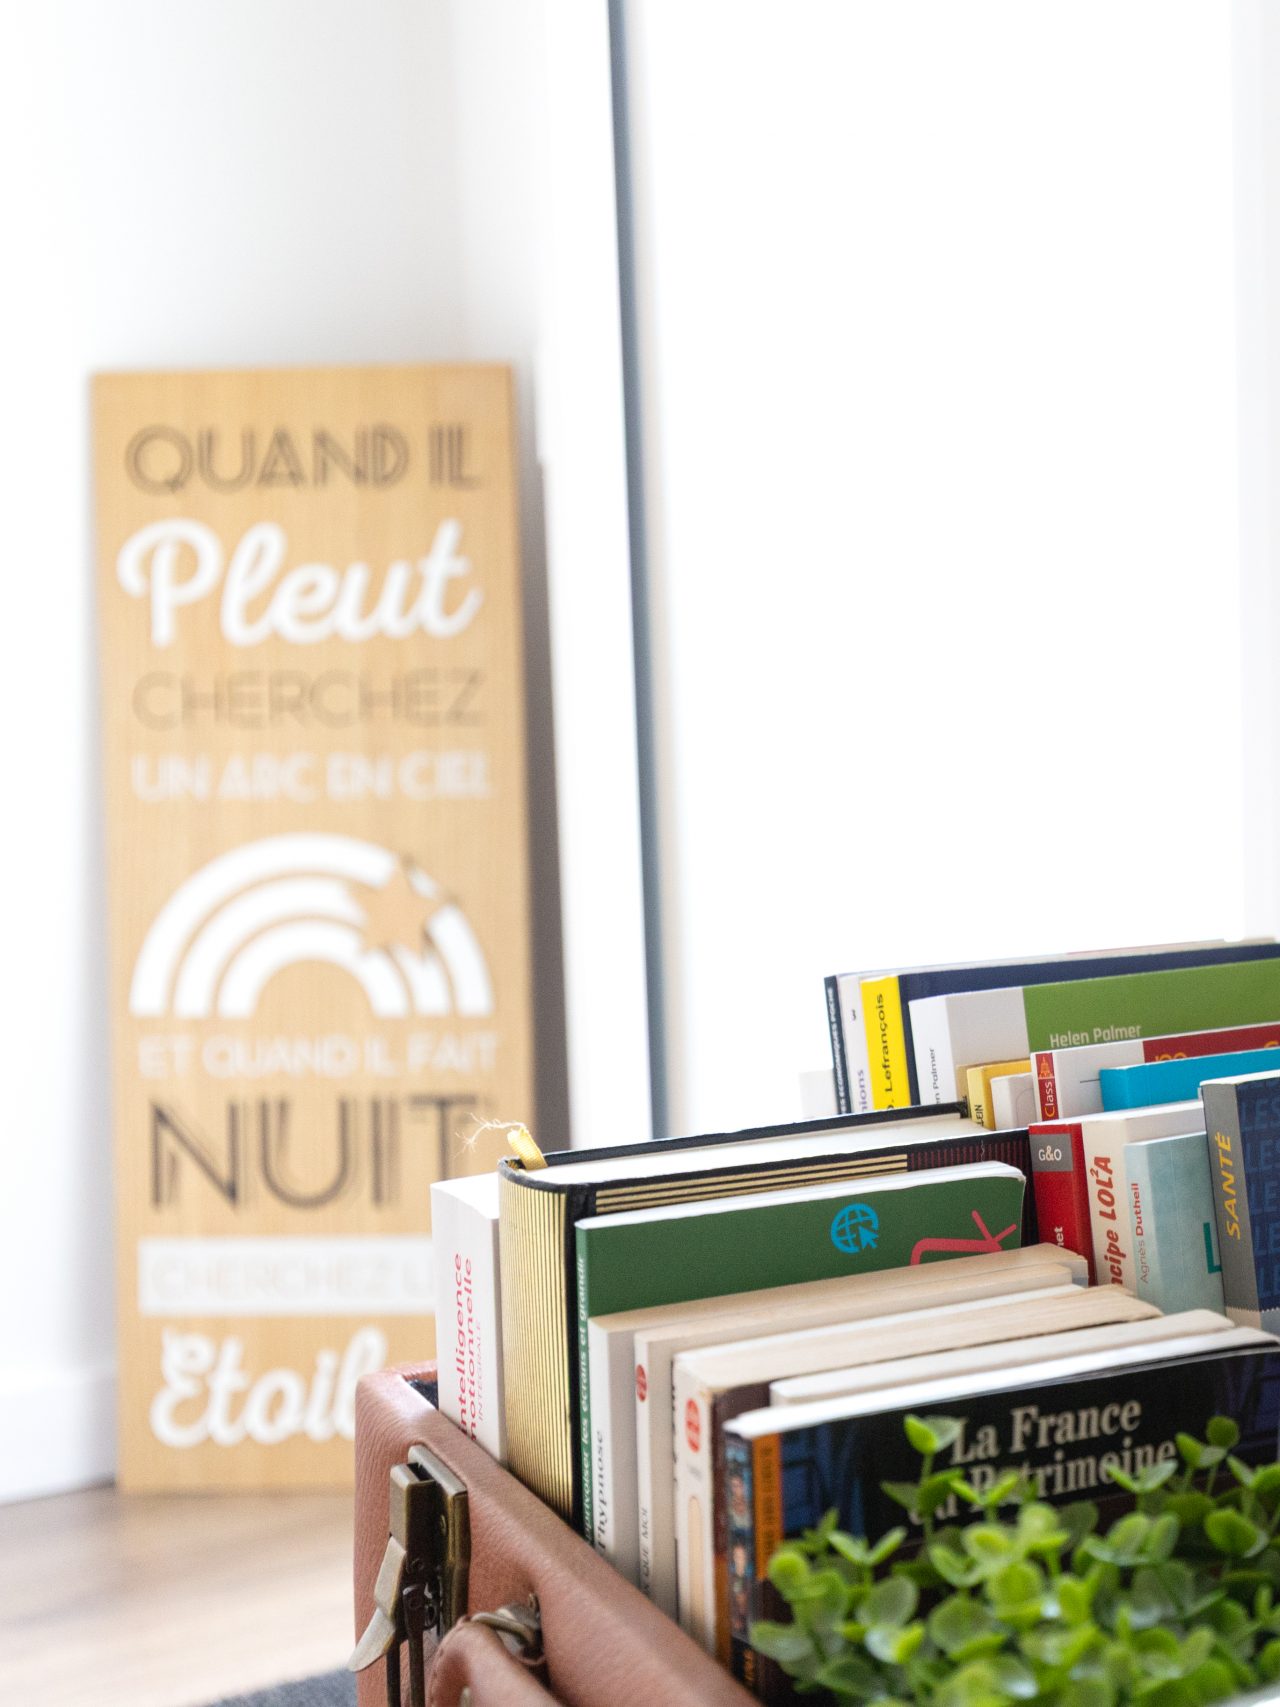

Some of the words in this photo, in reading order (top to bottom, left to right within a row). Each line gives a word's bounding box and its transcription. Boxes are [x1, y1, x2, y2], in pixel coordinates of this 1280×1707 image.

[125, 422, 410, 495] QUAND
[429, 423, 480, 490] IL
[116, 517, 482, 649] Pleut
[131, 667, 488, 732] CHERCHEZ
[131, 752, 210, 802] UN
[218, 752, 317, 802] ARC
[327, 750, 392, 800] EN
[402, 748, 492, 799] CIEL
[138, 1034, 193, 1078] ET
[202, 1034, 356, 1078] QUAND
[876, 993, 893, 1092] Lefrançois
[1050, 1031, 1089, 1049] Helen
[1093, 1025, 1142, 1043] Palmer
[149, 1092, 480, 1210] NUIT
[1038, 1145, 1062, 1162] G&O
[1130, 1182, 1145, 1237] Dutheil
[1214, 1131, 1241, 1241] SANTÉ
[1103, 1228, 1128, 1287] ncipe
[1137, 1239, 1150, 1284] Agnès
[151, 1325, 388, 1448] Etoil
[951, 1416, 999, 1467] La
[1010, 1399, 1143, 1455] France
